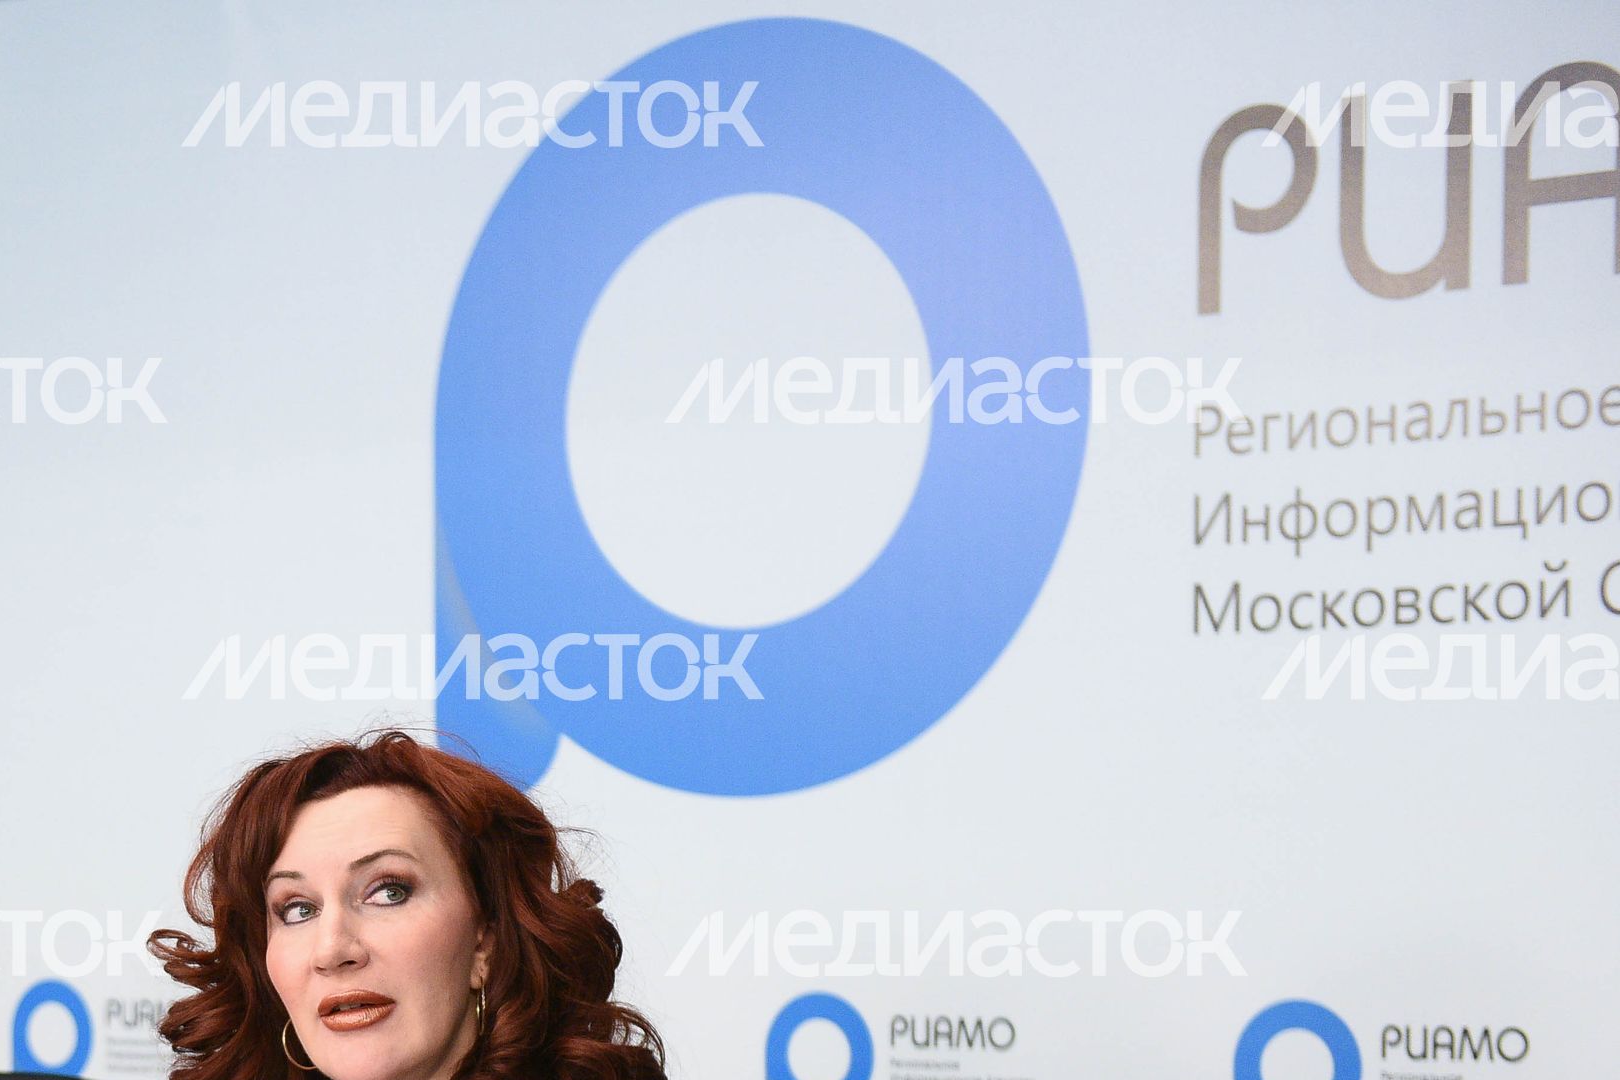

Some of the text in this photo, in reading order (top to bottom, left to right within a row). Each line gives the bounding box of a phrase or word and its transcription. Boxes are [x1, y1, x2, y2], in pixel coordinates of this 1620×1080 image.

[1192, 383, 1620, 459] Региональное
[1193, 479, 1620, 558] Информацио
[1191, 560, 1572, 636] Московской
[107, 998, 164, 1027] РИА
[890, 1014, 1016, 1051] РИАМО
[1381, 1024, 1529, 1062] РИАМО
